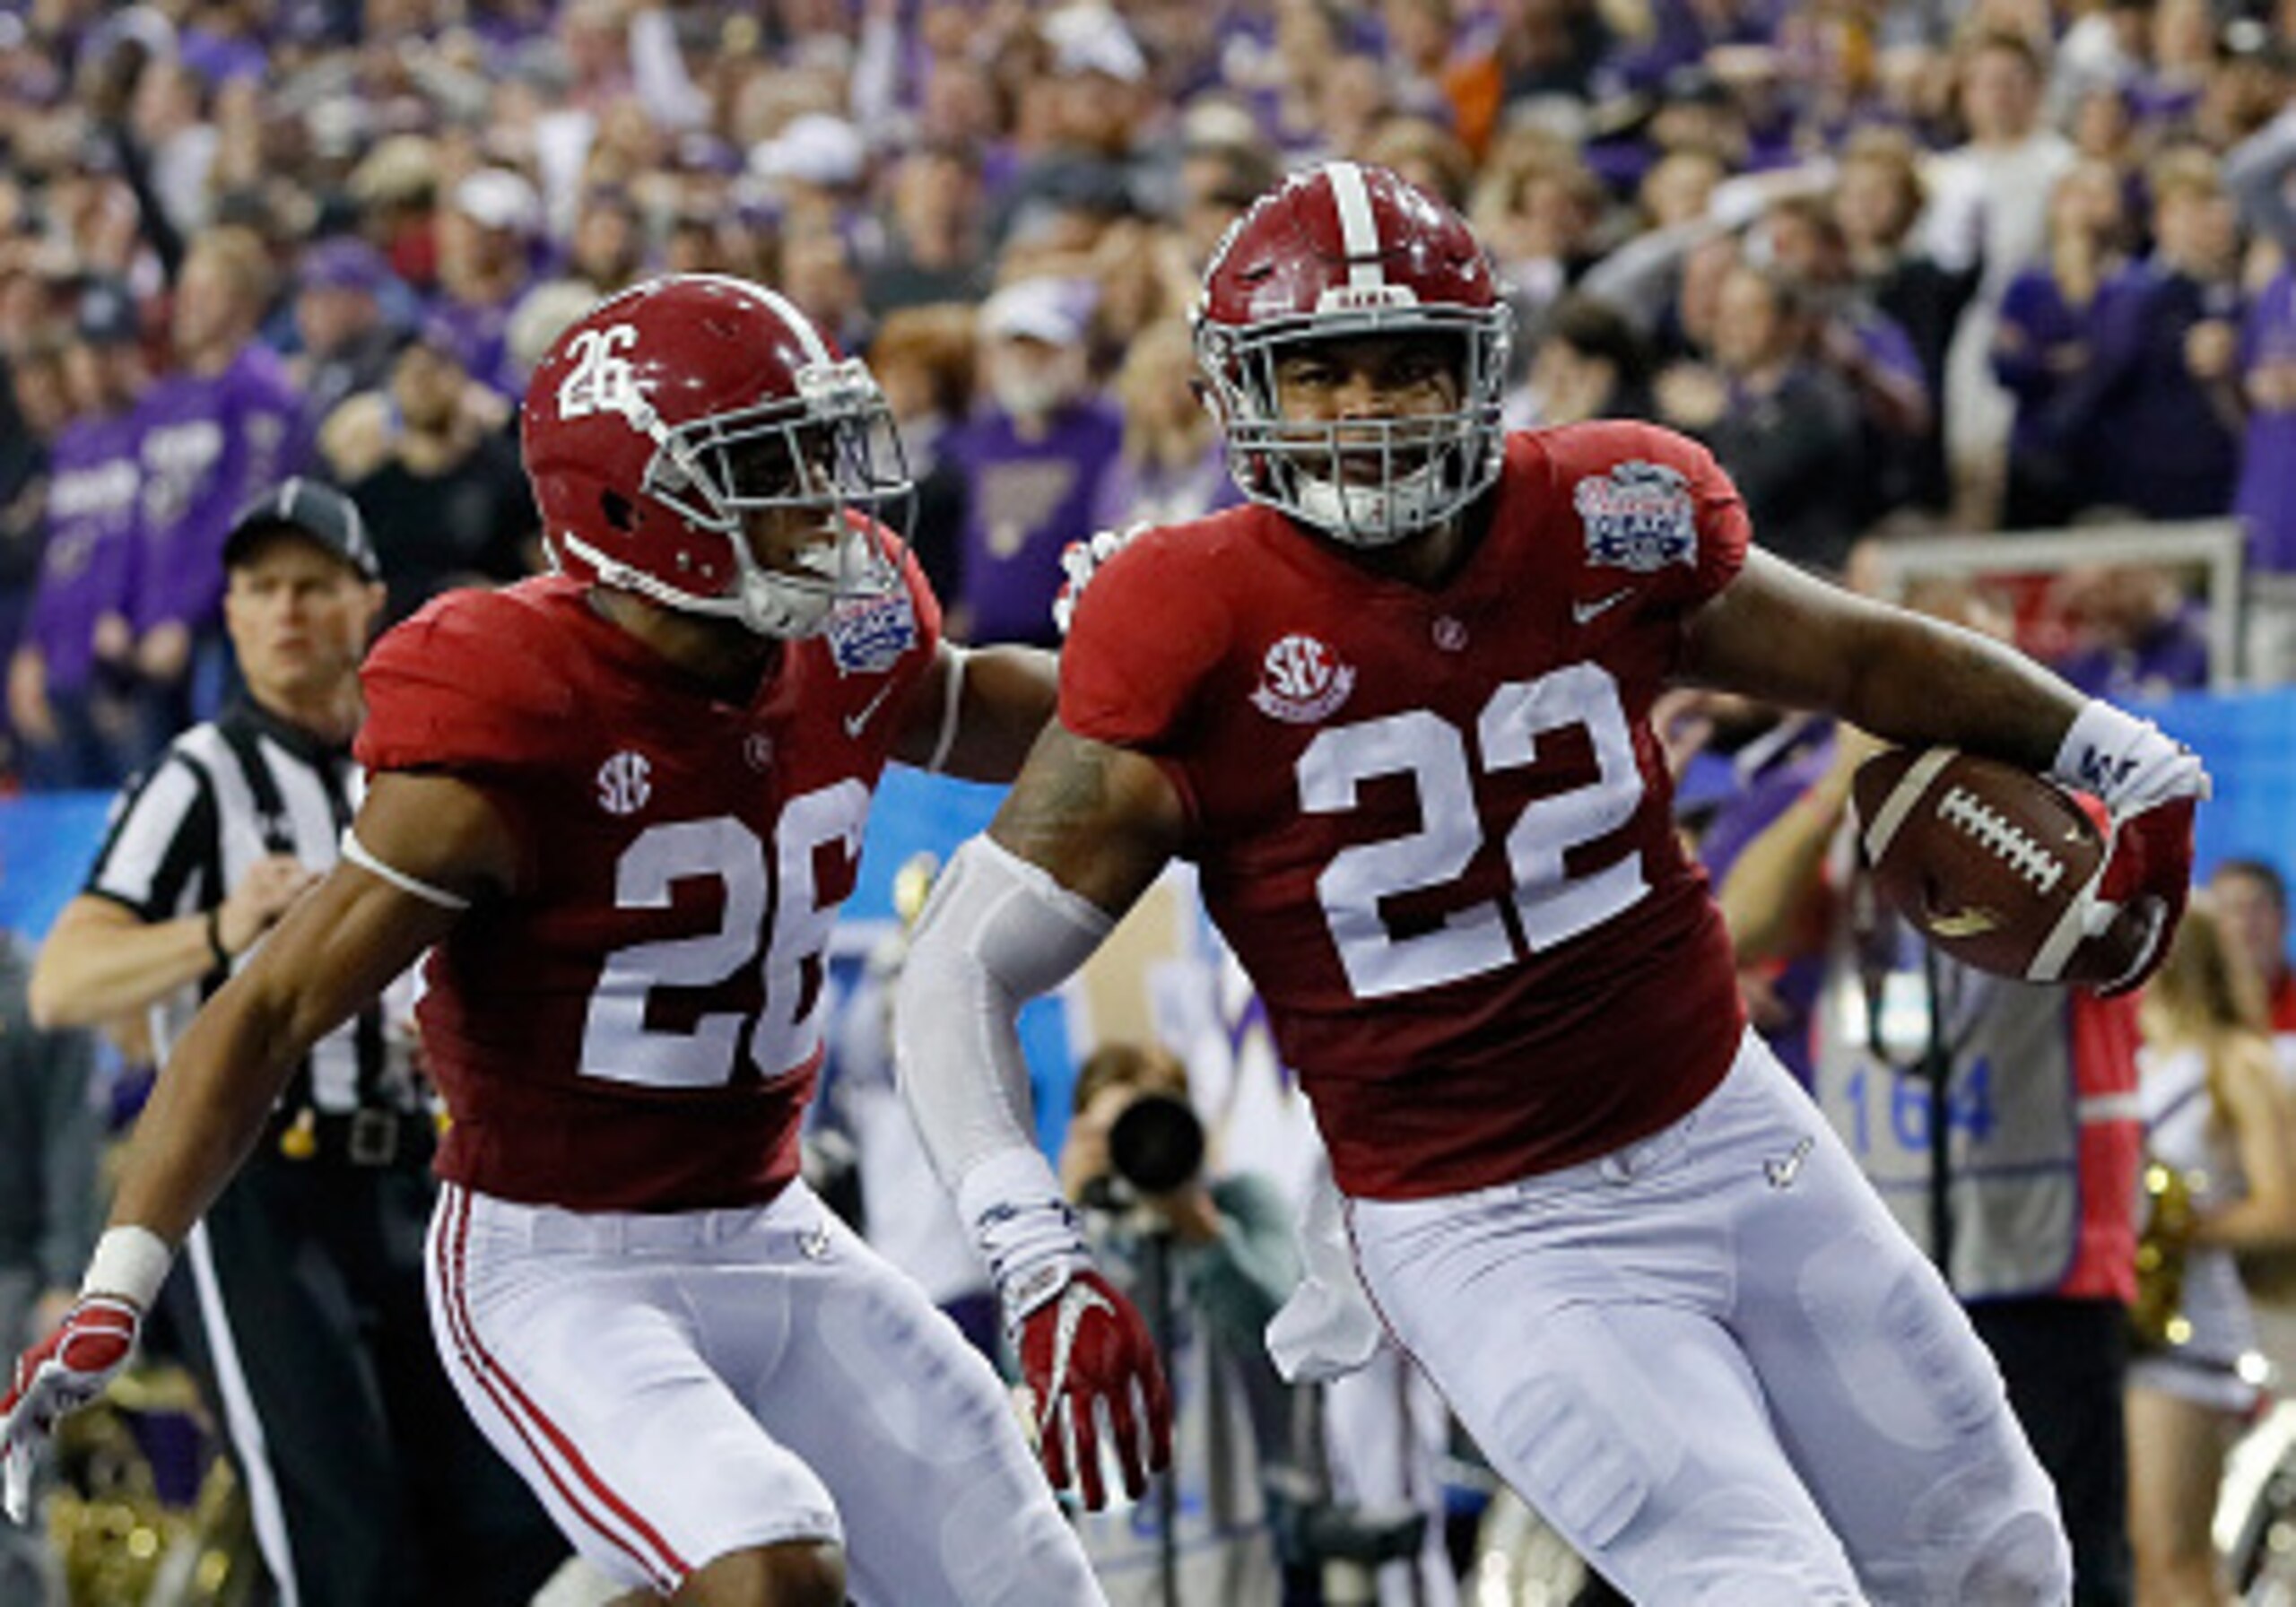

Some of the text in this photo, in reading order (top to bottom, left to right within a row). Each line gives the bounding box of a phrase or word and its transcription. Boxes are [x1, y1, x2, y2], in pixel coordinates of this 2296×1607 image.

[558, 323, 639, 421] 26
[1264, 633, 1328, 699] SEC
[596, 750, 653, 815] SEC
[1294, 660, 1653, 999] 22
[577, 787, 870, 1089] 26
[1844, 1053, 1997, 1159] 164
